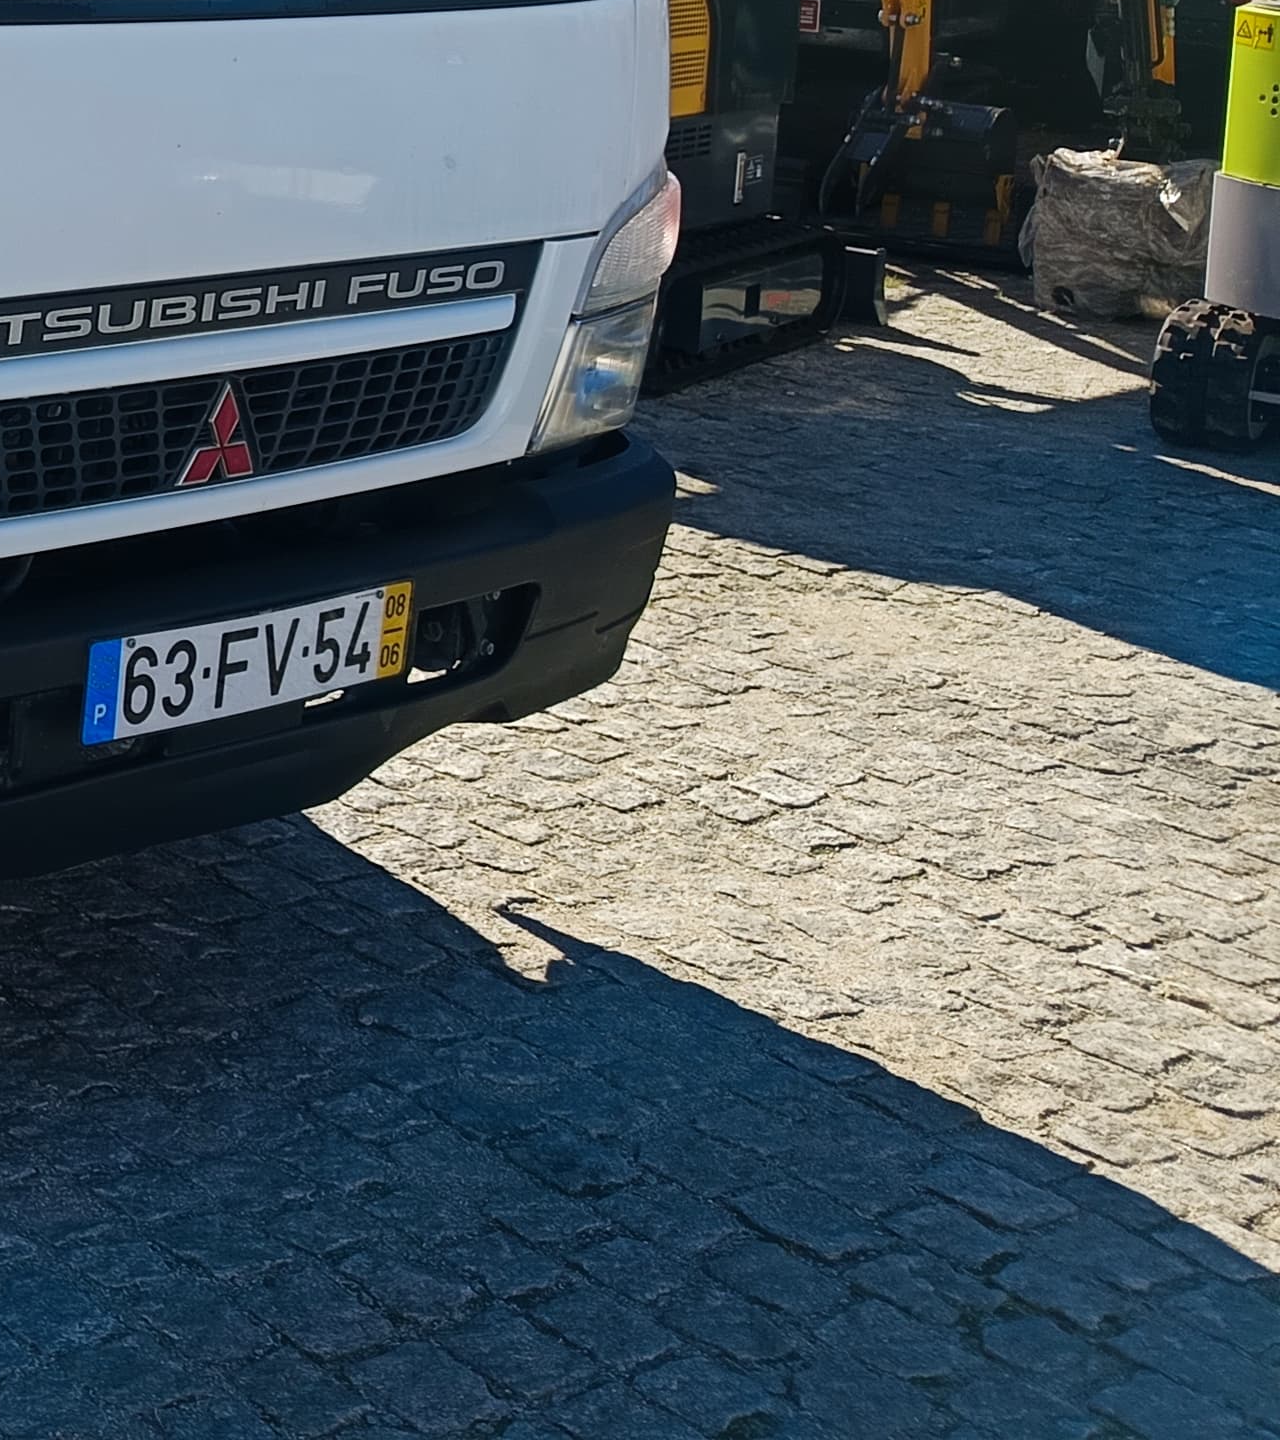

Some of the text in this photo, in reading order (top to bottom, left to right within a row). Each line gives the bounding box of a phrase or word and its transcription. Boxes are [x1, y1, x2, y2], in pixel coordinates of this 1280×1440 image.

[346, 260, 506, 305] FUSO
[385, 593, 406, 619] 08
[380, 642, 400, 668] 06
[93, 703, 107, 725] P
